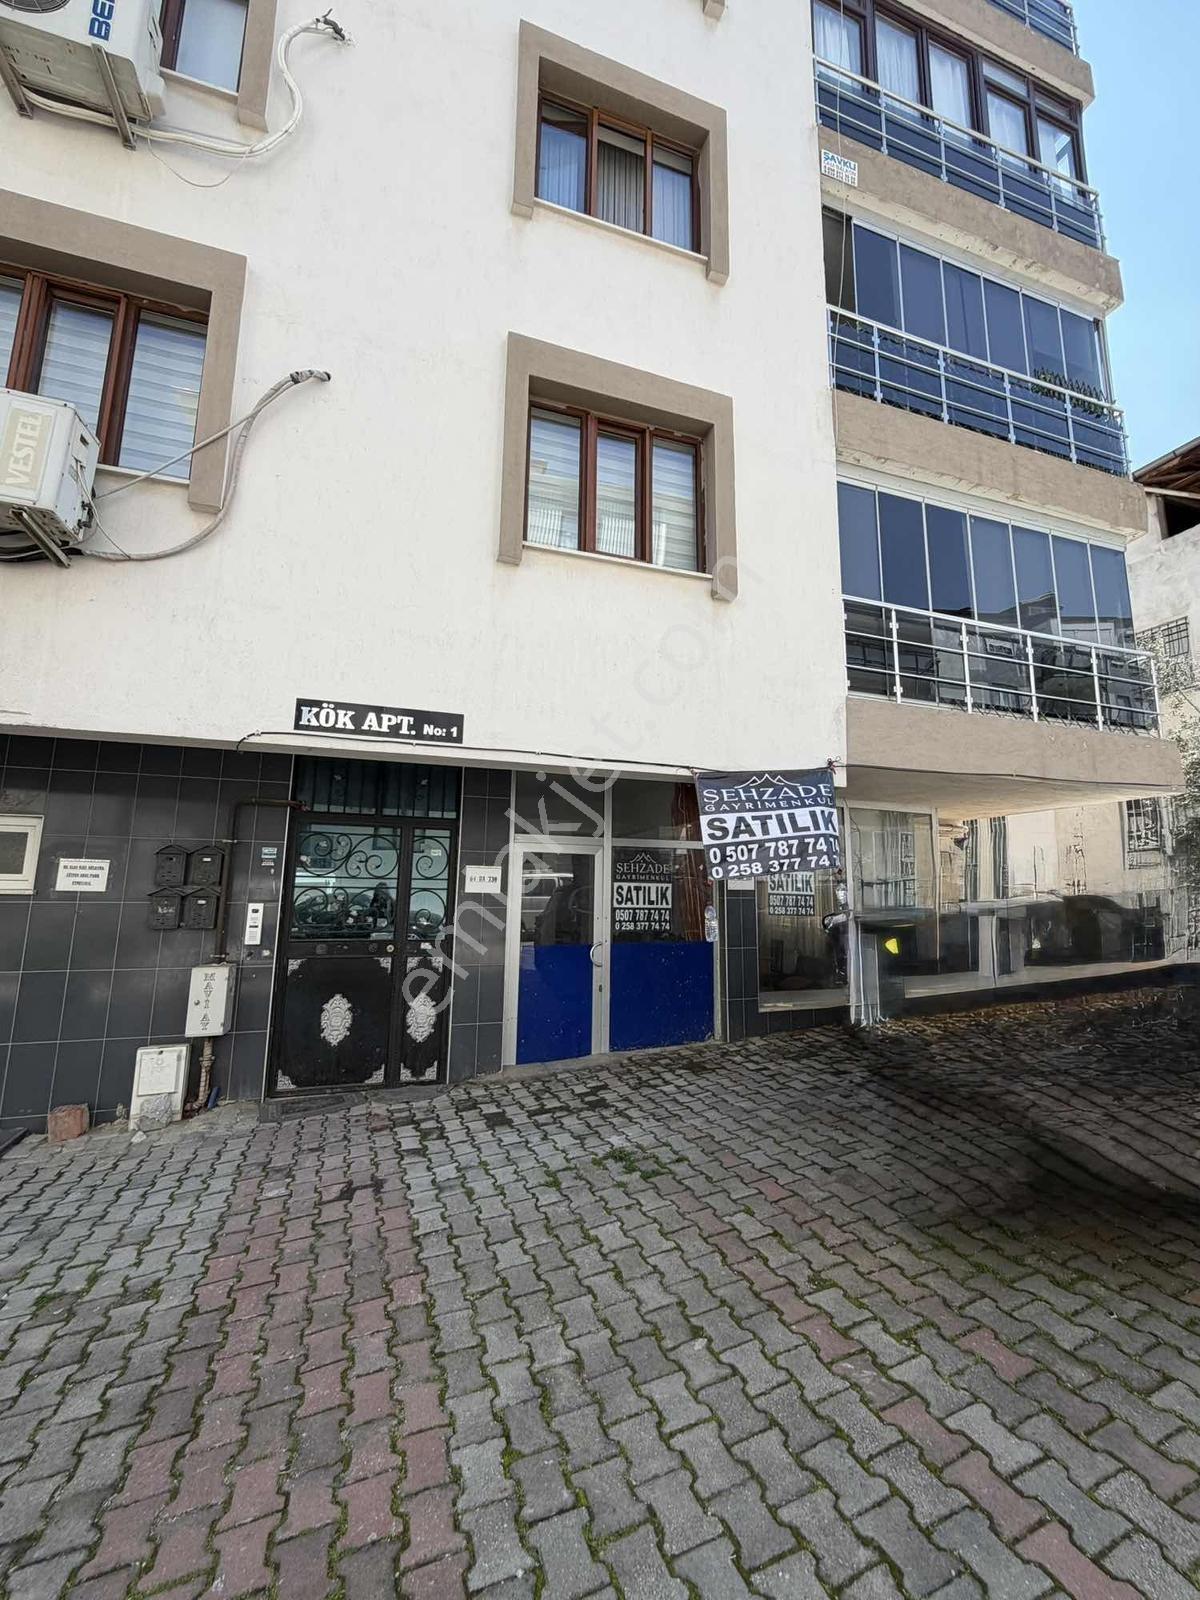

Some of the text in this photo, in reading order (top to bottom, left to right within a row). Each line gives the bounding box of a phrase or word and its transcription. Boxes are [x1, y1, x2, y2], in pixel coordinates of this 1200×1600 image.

[88, 0, 116, 41] BE
[5, 413, 42, 485] VESTEL
[299, 703, 458, 737] KÖK APT. No: 1
[703, 784, 832, 803] ŞEHZADE
[706, 810, 836, 841] SATILIK
[709, 847, 721, 863] 0
[726, 844, 758, 862] 507
[765, 839, 798, 857] 787
[804, 837, 827, 854] 74
[616, 862, 670, 874] ŞEHZADE
[712, 866, 723, 879] 0
[728, 862, 762, 877] 258
[768, 858, 801, 872] 377
[807, 855, 830, 868] 74
[769, 873, 813, 893] SATILIK
[616, 885, 670, 906] SATILIK
[615, 909, 670, 921] 0507 787 74 74
[636, 922, 648, 930] 377
[651, 922, 659, 930] 74
[661, 922, 670, 930] 74
